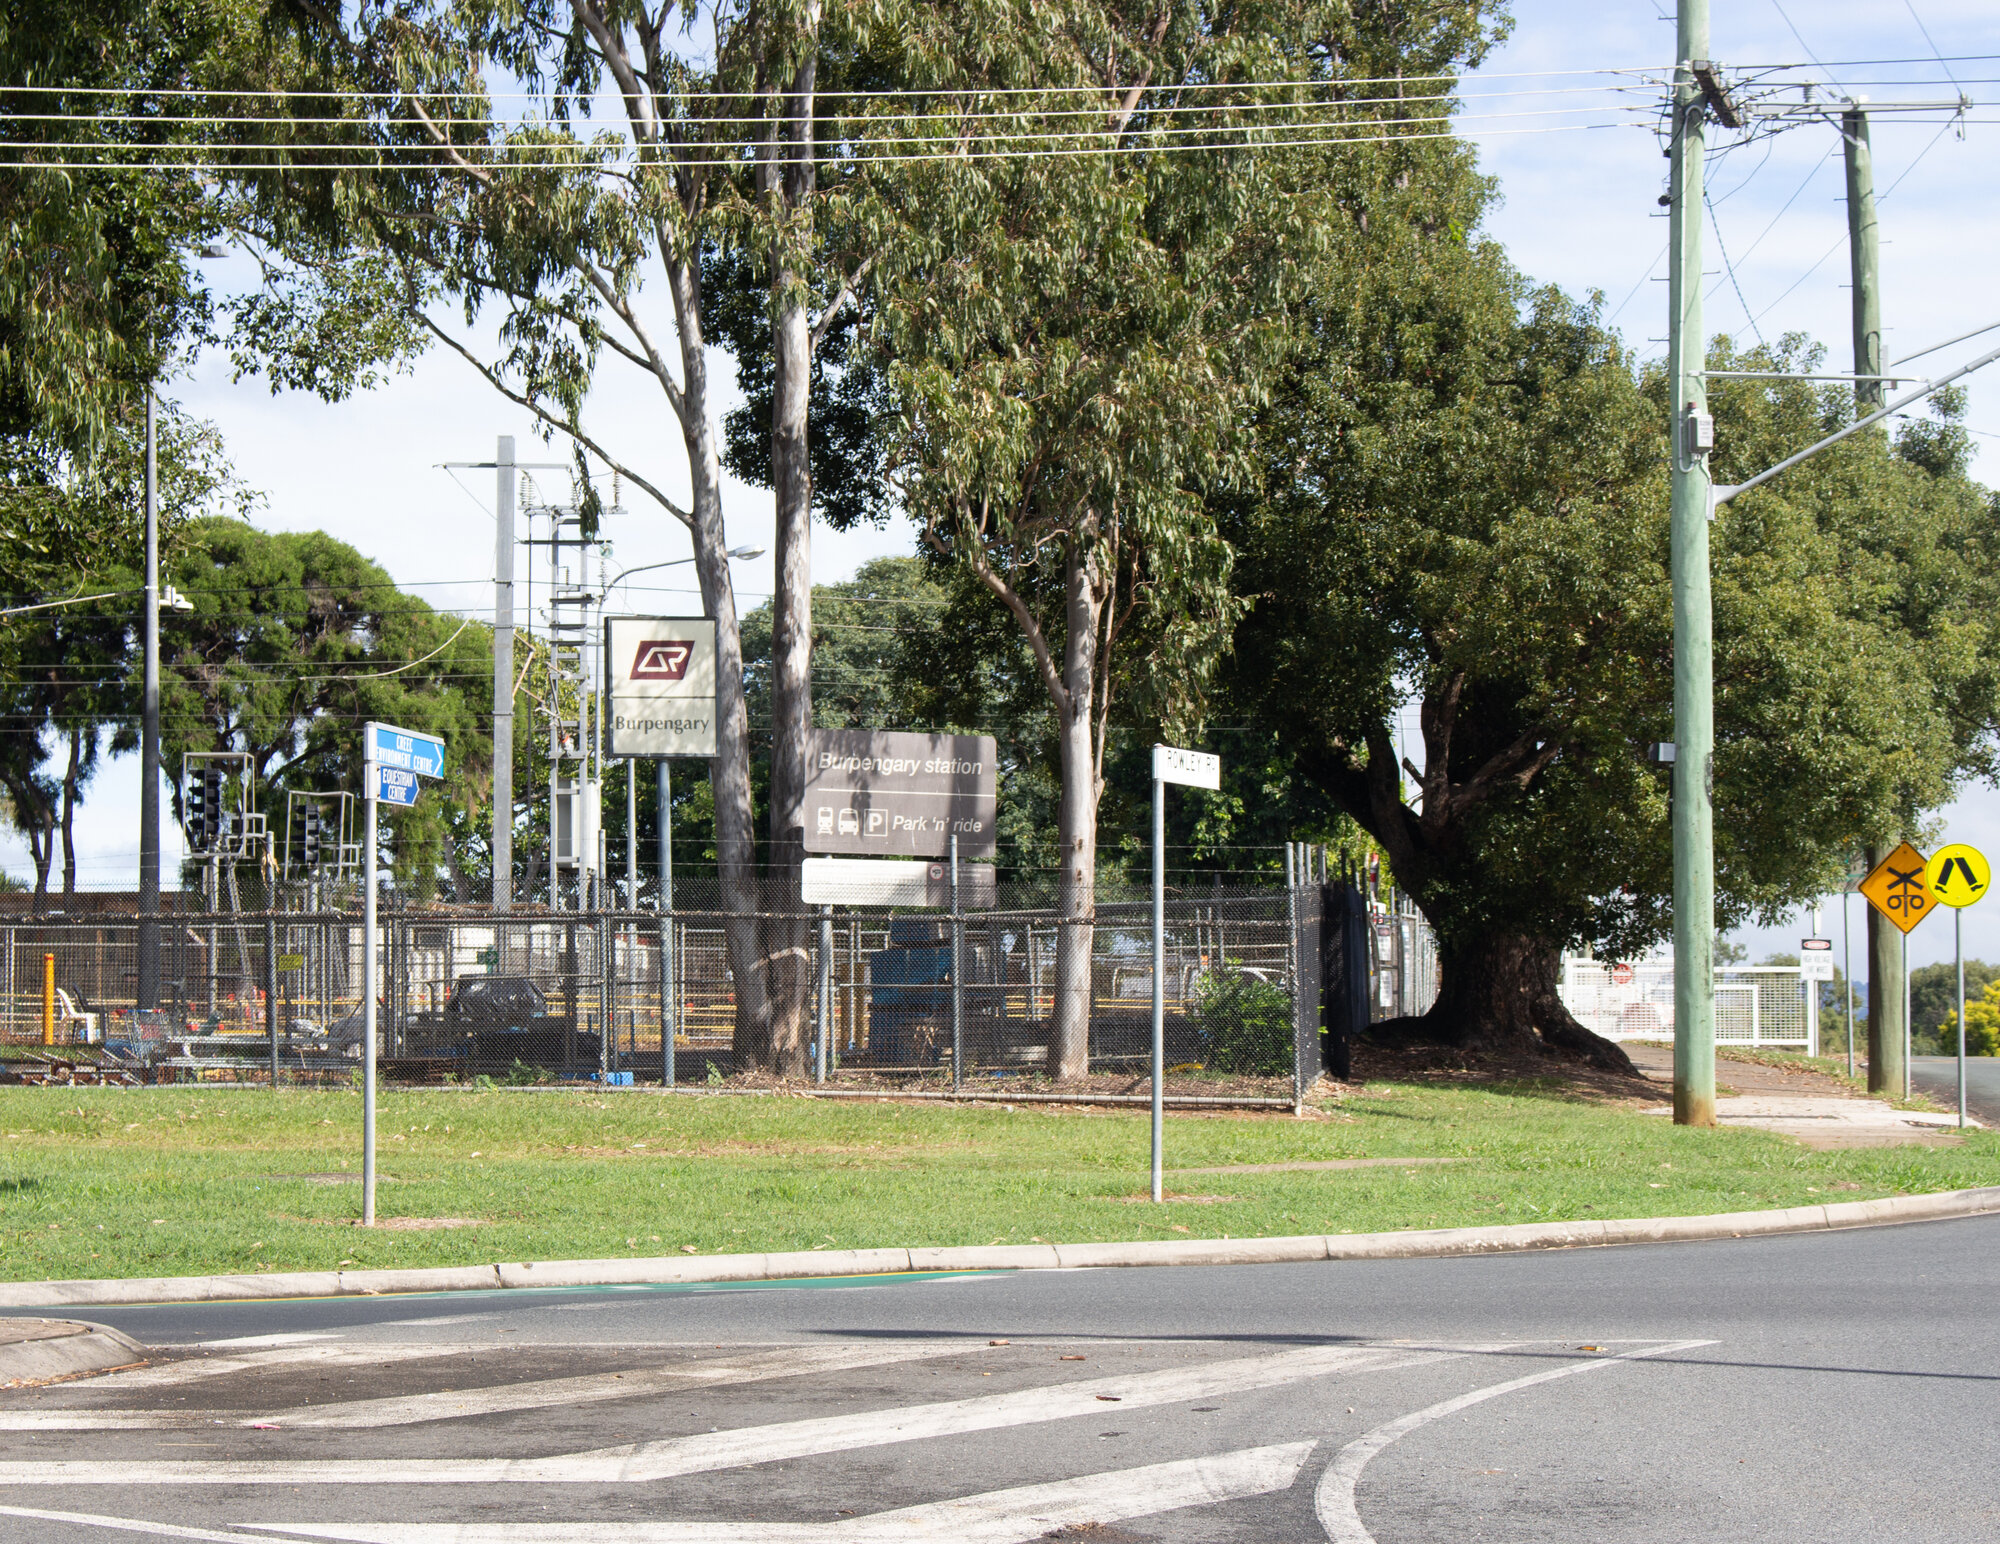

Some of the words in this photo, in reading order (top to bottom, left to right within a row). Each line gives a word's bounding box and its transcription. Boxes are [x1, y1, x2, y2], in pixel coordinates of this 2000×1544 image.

[615, 715, 709, 734] Burpengary
[396, 735, 413, 752] CREEC
[413, 755, 433, 773] CENTRE
[818, 752, 921, 776] Burpengary
[924, 757, 983, 775] station
[1168, 749, 1201, 772] ROWLEY
[382, 768, 413, 787] EQUESTRIAN
[388, 785, 407, 801] CENTRE
[892, 815, 926, 831] Park
[953, 818, 982, 832] ride
